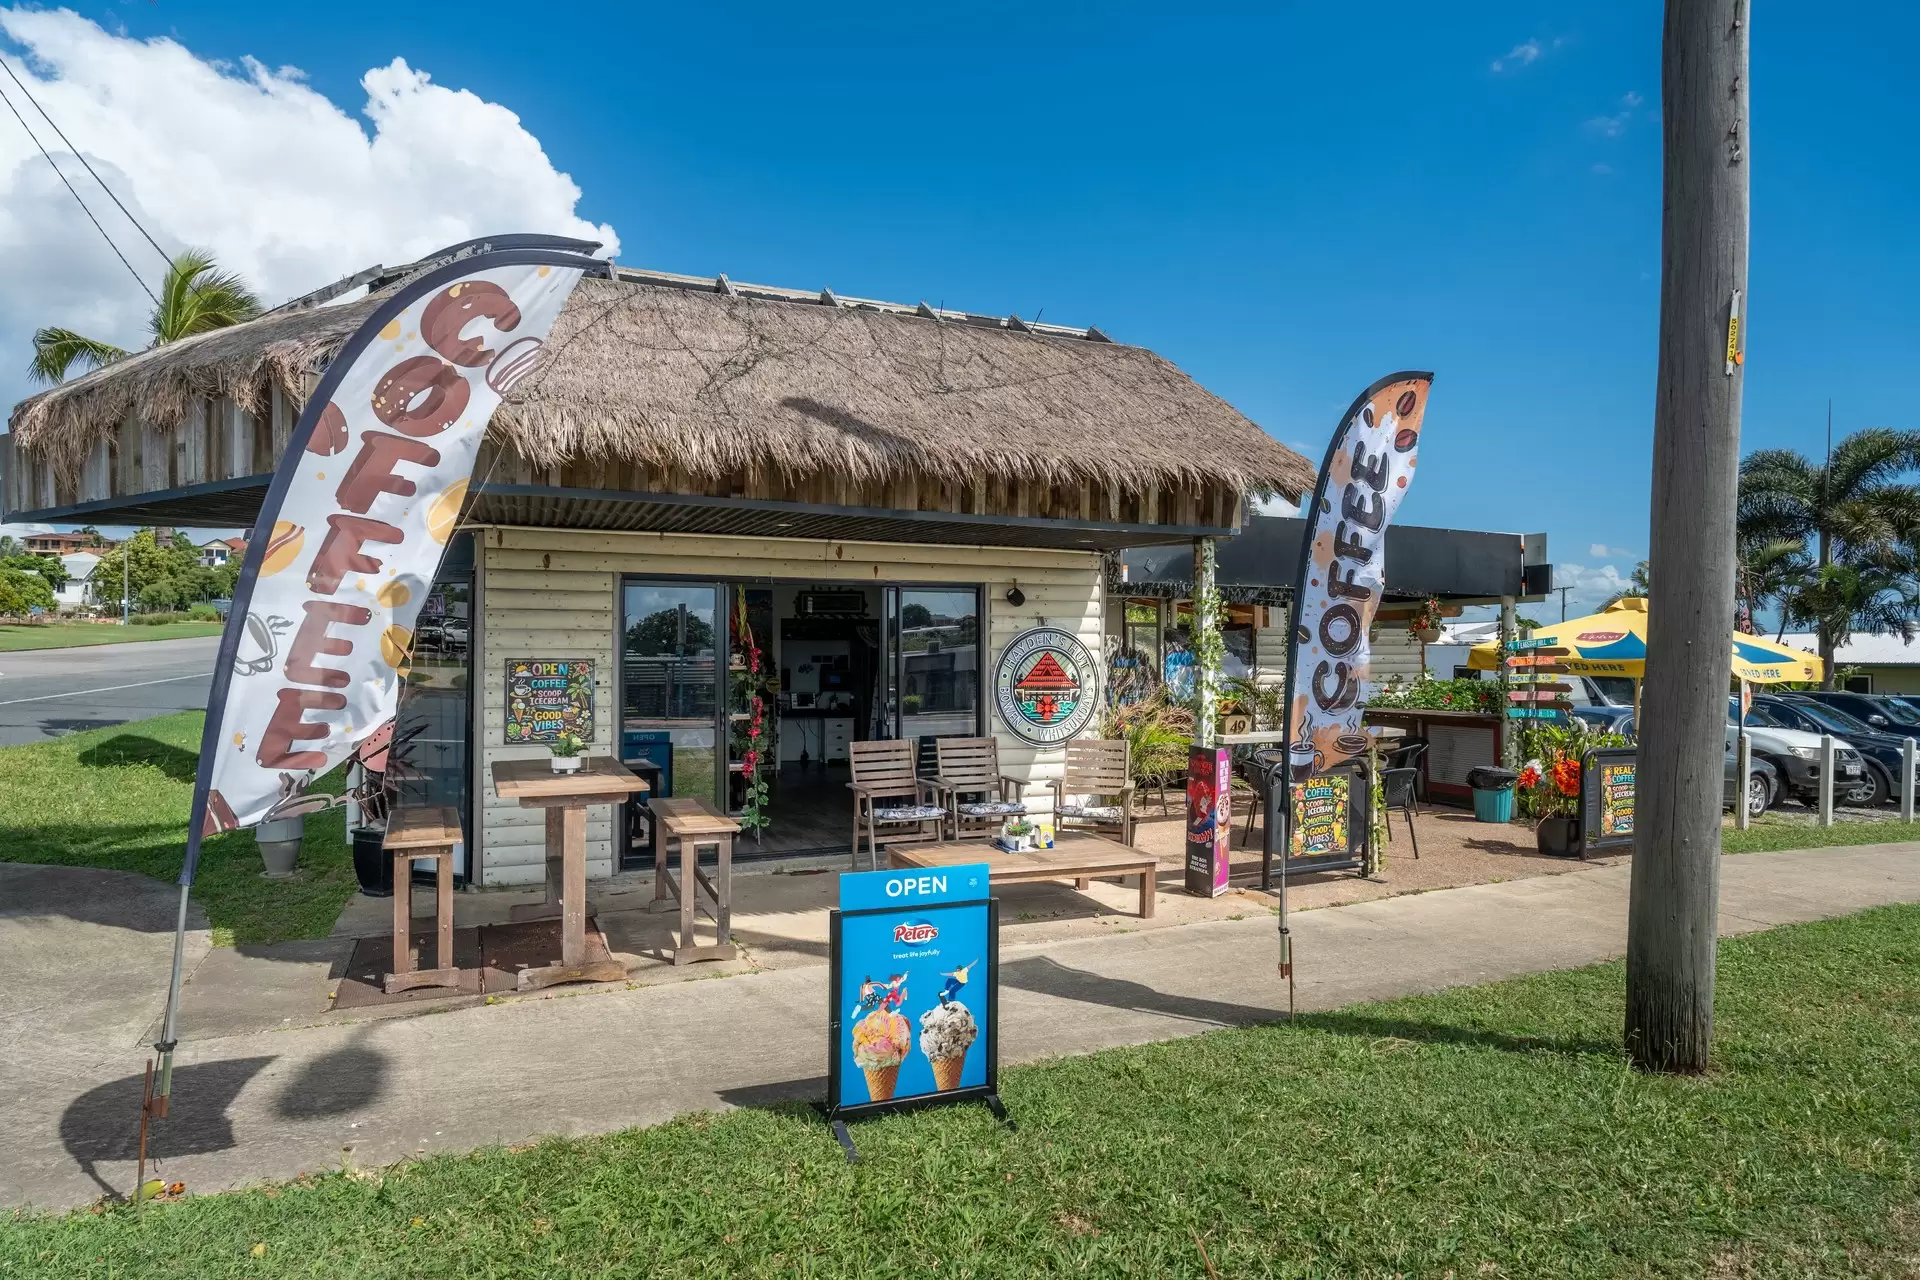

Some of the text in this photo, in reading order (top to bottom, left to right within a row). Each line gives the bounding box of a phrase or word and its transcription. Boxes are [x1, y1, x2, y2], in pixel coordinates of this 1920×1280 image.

[256, 280, 521, 770] COFFEE
[1312, 440, 1388, 716] COFFEE
[1004, 633, 1090, 670] HAYDEN'S HUT
[532, 663, 569, 675] OPEN
[1763, 669, 1781, 678] HERE
[531, 679, 568, 688] COFFEE
[530, 697, 569, 705] ICECREAM
[534, 711, 562, 720] GOOD
[1000, 686, 1094, 740] BOWEN WHITSUNDAYS
[532, 720, 564, 731] VIBES
[1230, 719, 1246, 734] 49
[1613, 766, 1633, 775] REAL
[1307, 778, 1331, 788] REAL
[1612, 774, 1636, 783] COFFEE
[1305, 787, 1334, 798] COFFEE
[1305, 800, 1325, 809] SCOOP
[1308, 805, 1333, 816] ICECREAM
[1616, 808, 1632, 817] GOOD
[1304, 815, 1333, 827] SMOOTHIES
[1615, 815, 1634, 825] VIBES
[1309, 826, 1329, 836] GOOD
[1307, 832, 1330, 845] VIBES
[885, 876, 947, 897] OPEN
[894, 925, 938, 941] Peters
[919, 949, 940, 958] joyfully
